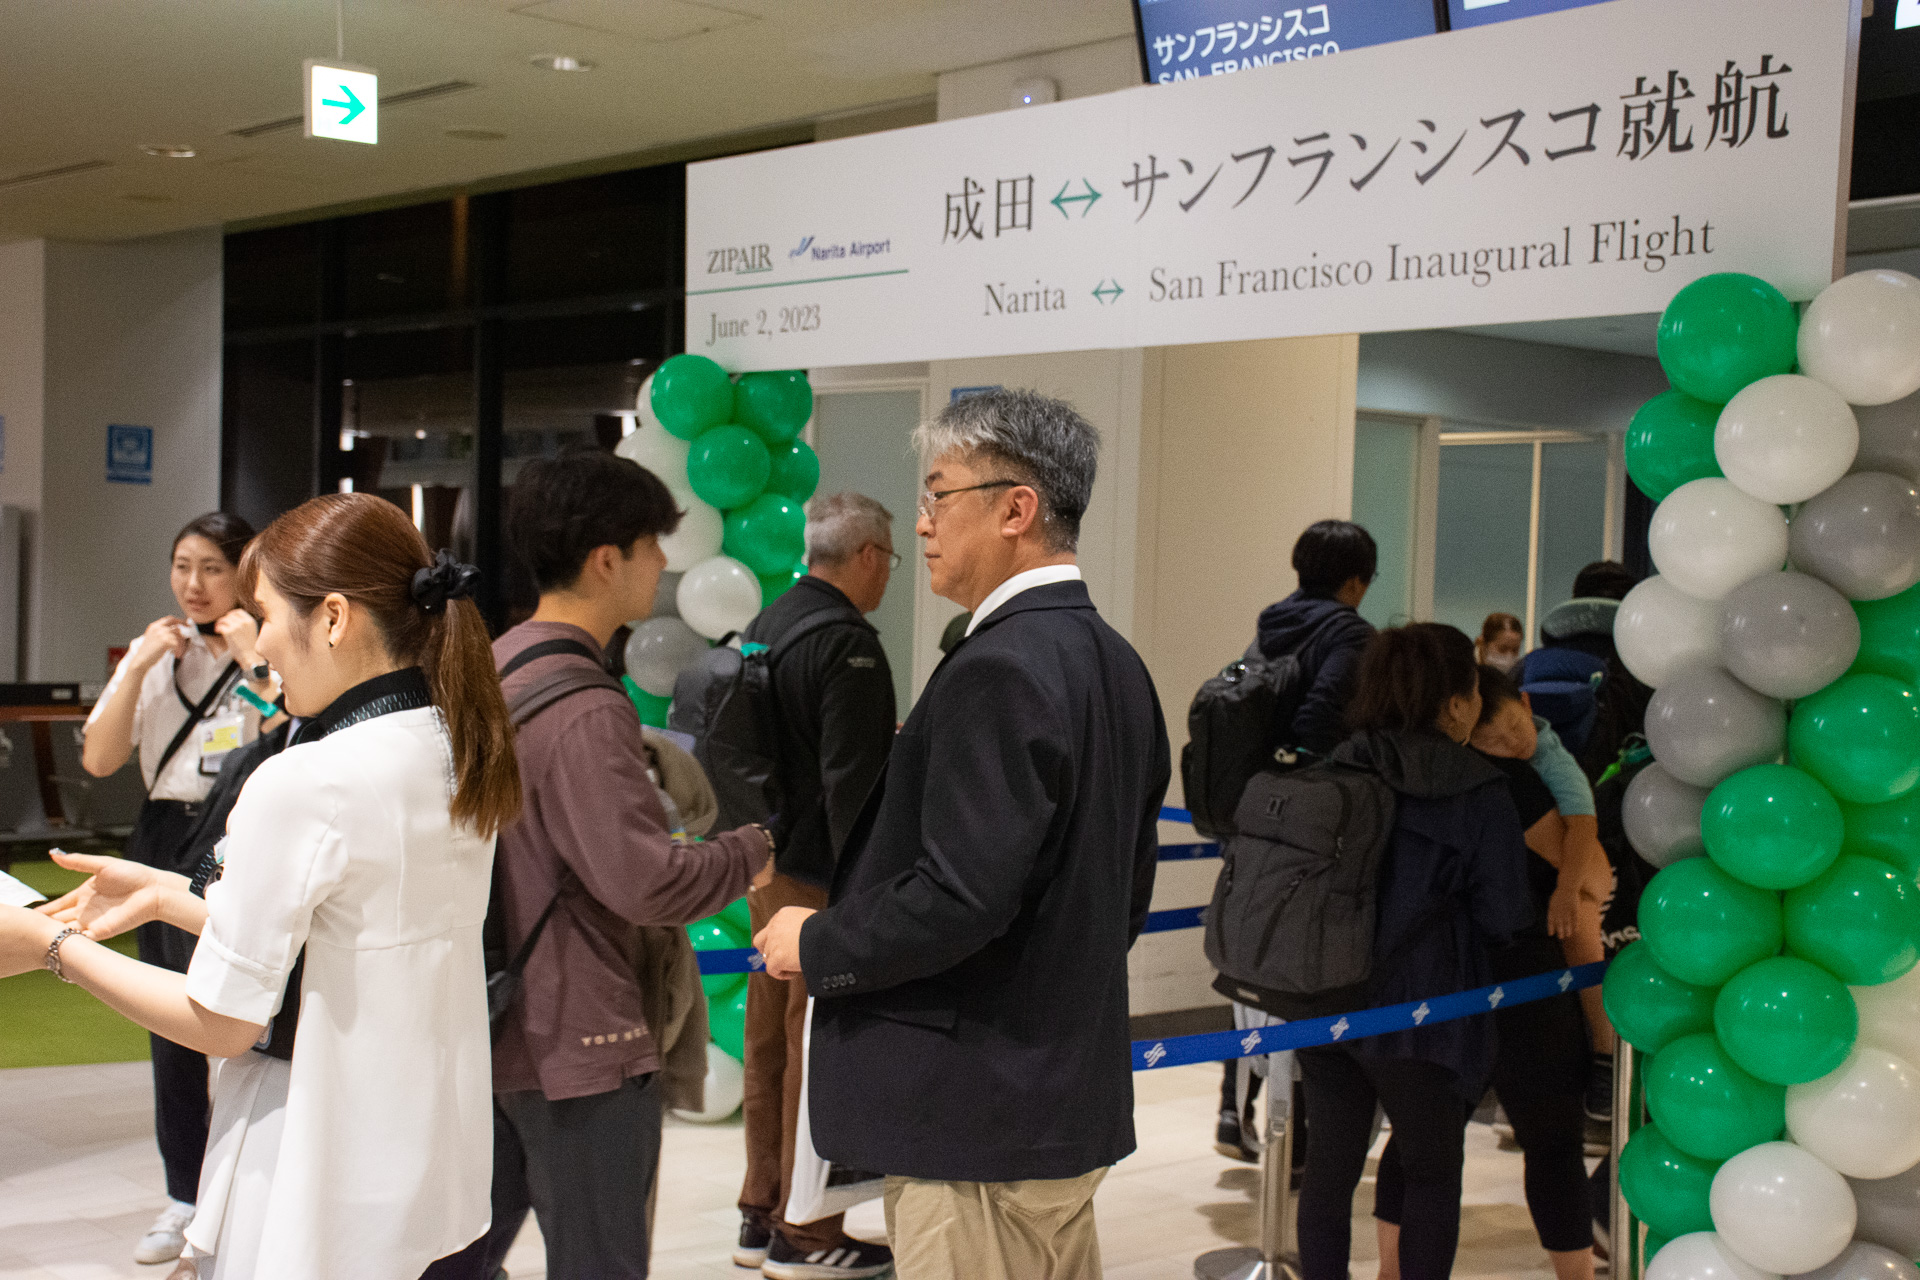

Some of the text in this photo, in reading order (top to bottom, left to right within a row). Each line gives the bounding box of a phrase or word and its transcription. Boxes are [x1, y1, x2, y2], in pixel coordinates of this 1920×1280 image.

[1153, 4, 1331, 66] サンフランシスコ
[942, 54, 1793, 244] 成田 サンフランシスコ就航
[706, 243, 773, 275] ZIPAIR
[811, 238, 892, 262] Narita Airport
[984, 214, 1716, 317] Narita San Francisco Inaugural Flight
[706, 303, 822, 346] June 2, 2023
